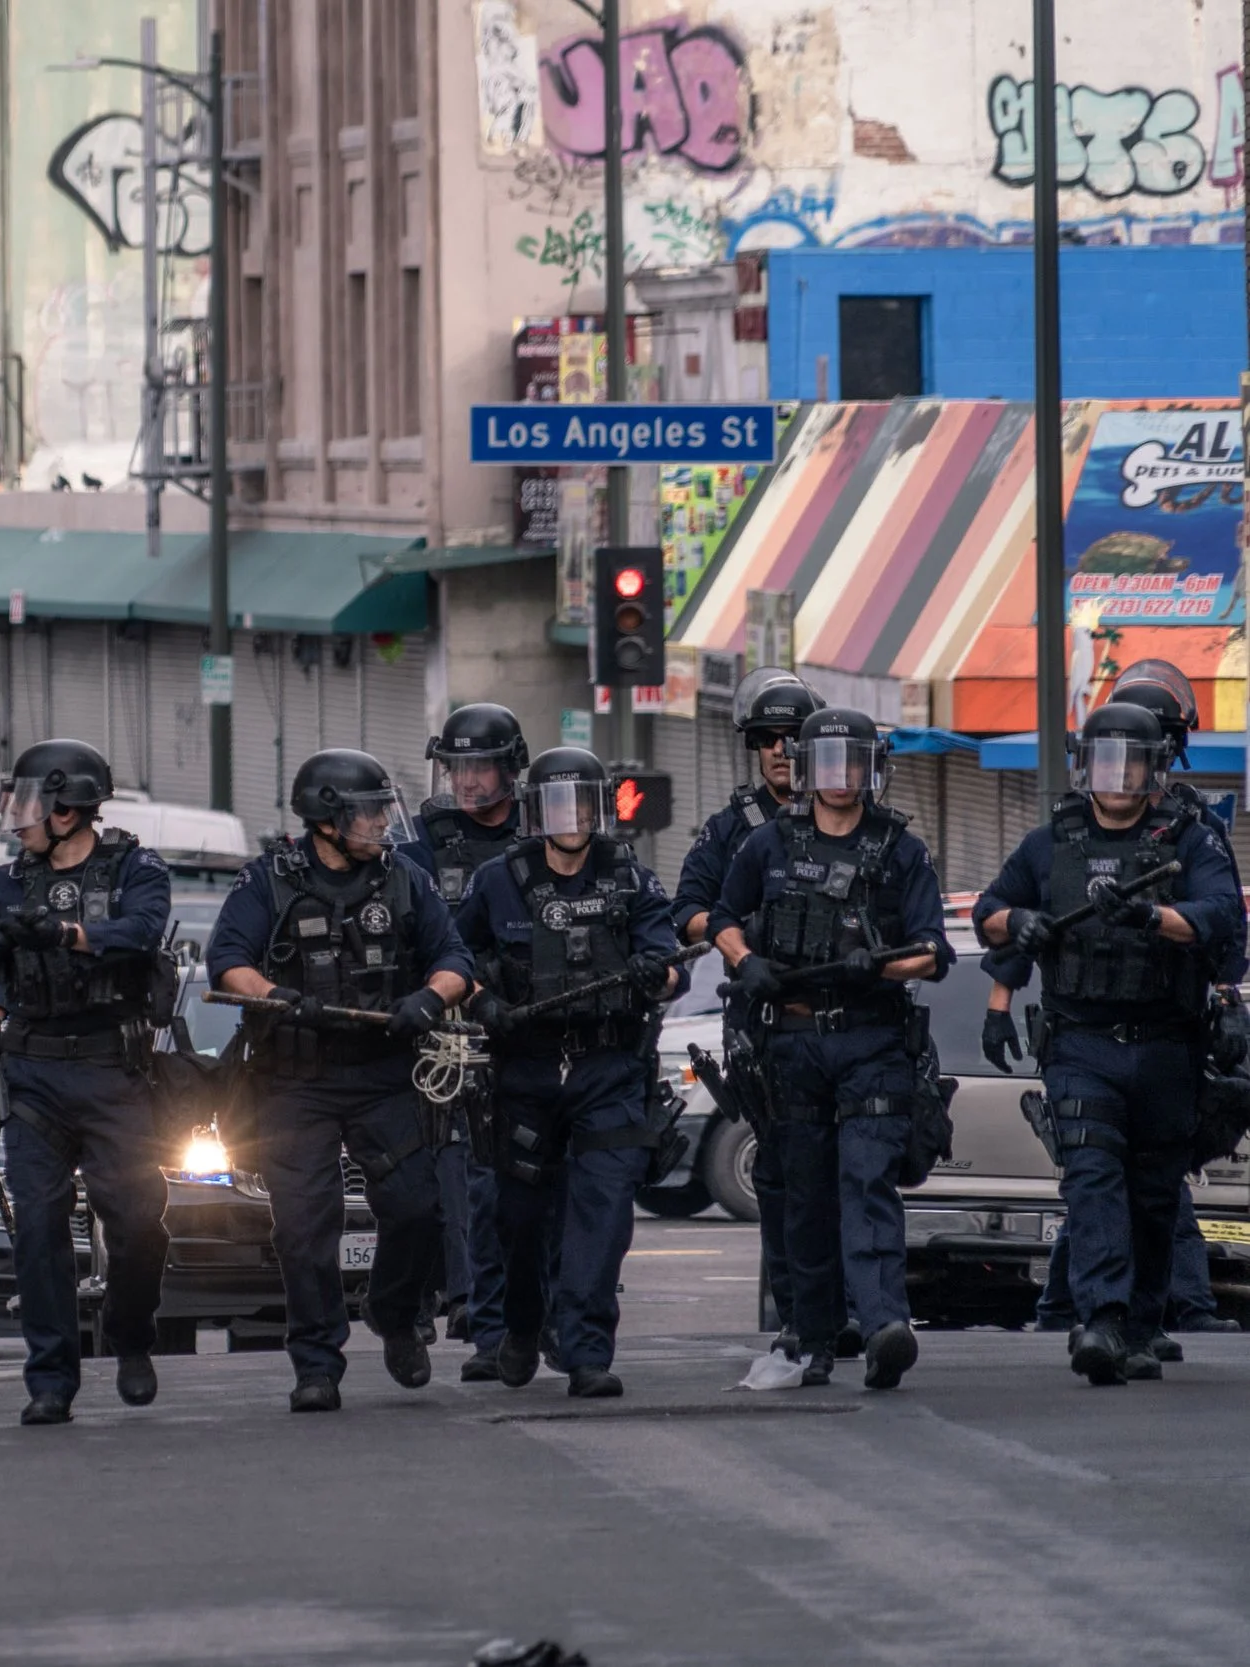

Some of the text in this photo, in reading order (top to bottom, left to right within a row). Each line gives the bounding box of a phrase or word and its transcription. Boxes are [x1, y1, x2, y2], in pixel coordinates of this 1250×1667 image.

[488, 415, 758, 457] Los Angeles St
[1135, 464, 1244, 478] PETS & SUP
[1072, 574, 1112, 591] OPEN
[764, 706, 795, 716] GUTIERREZ
[820, 725, 849, 734] NGUYEN
[550, 772, 580, 781] MULCAHY
[769, 870, 786, 878] NGU
[796, 869, 820, 879] POLICE
[1091, 865, 1116, 873] POLICE
[576, 905, 602, 915] POLICE
